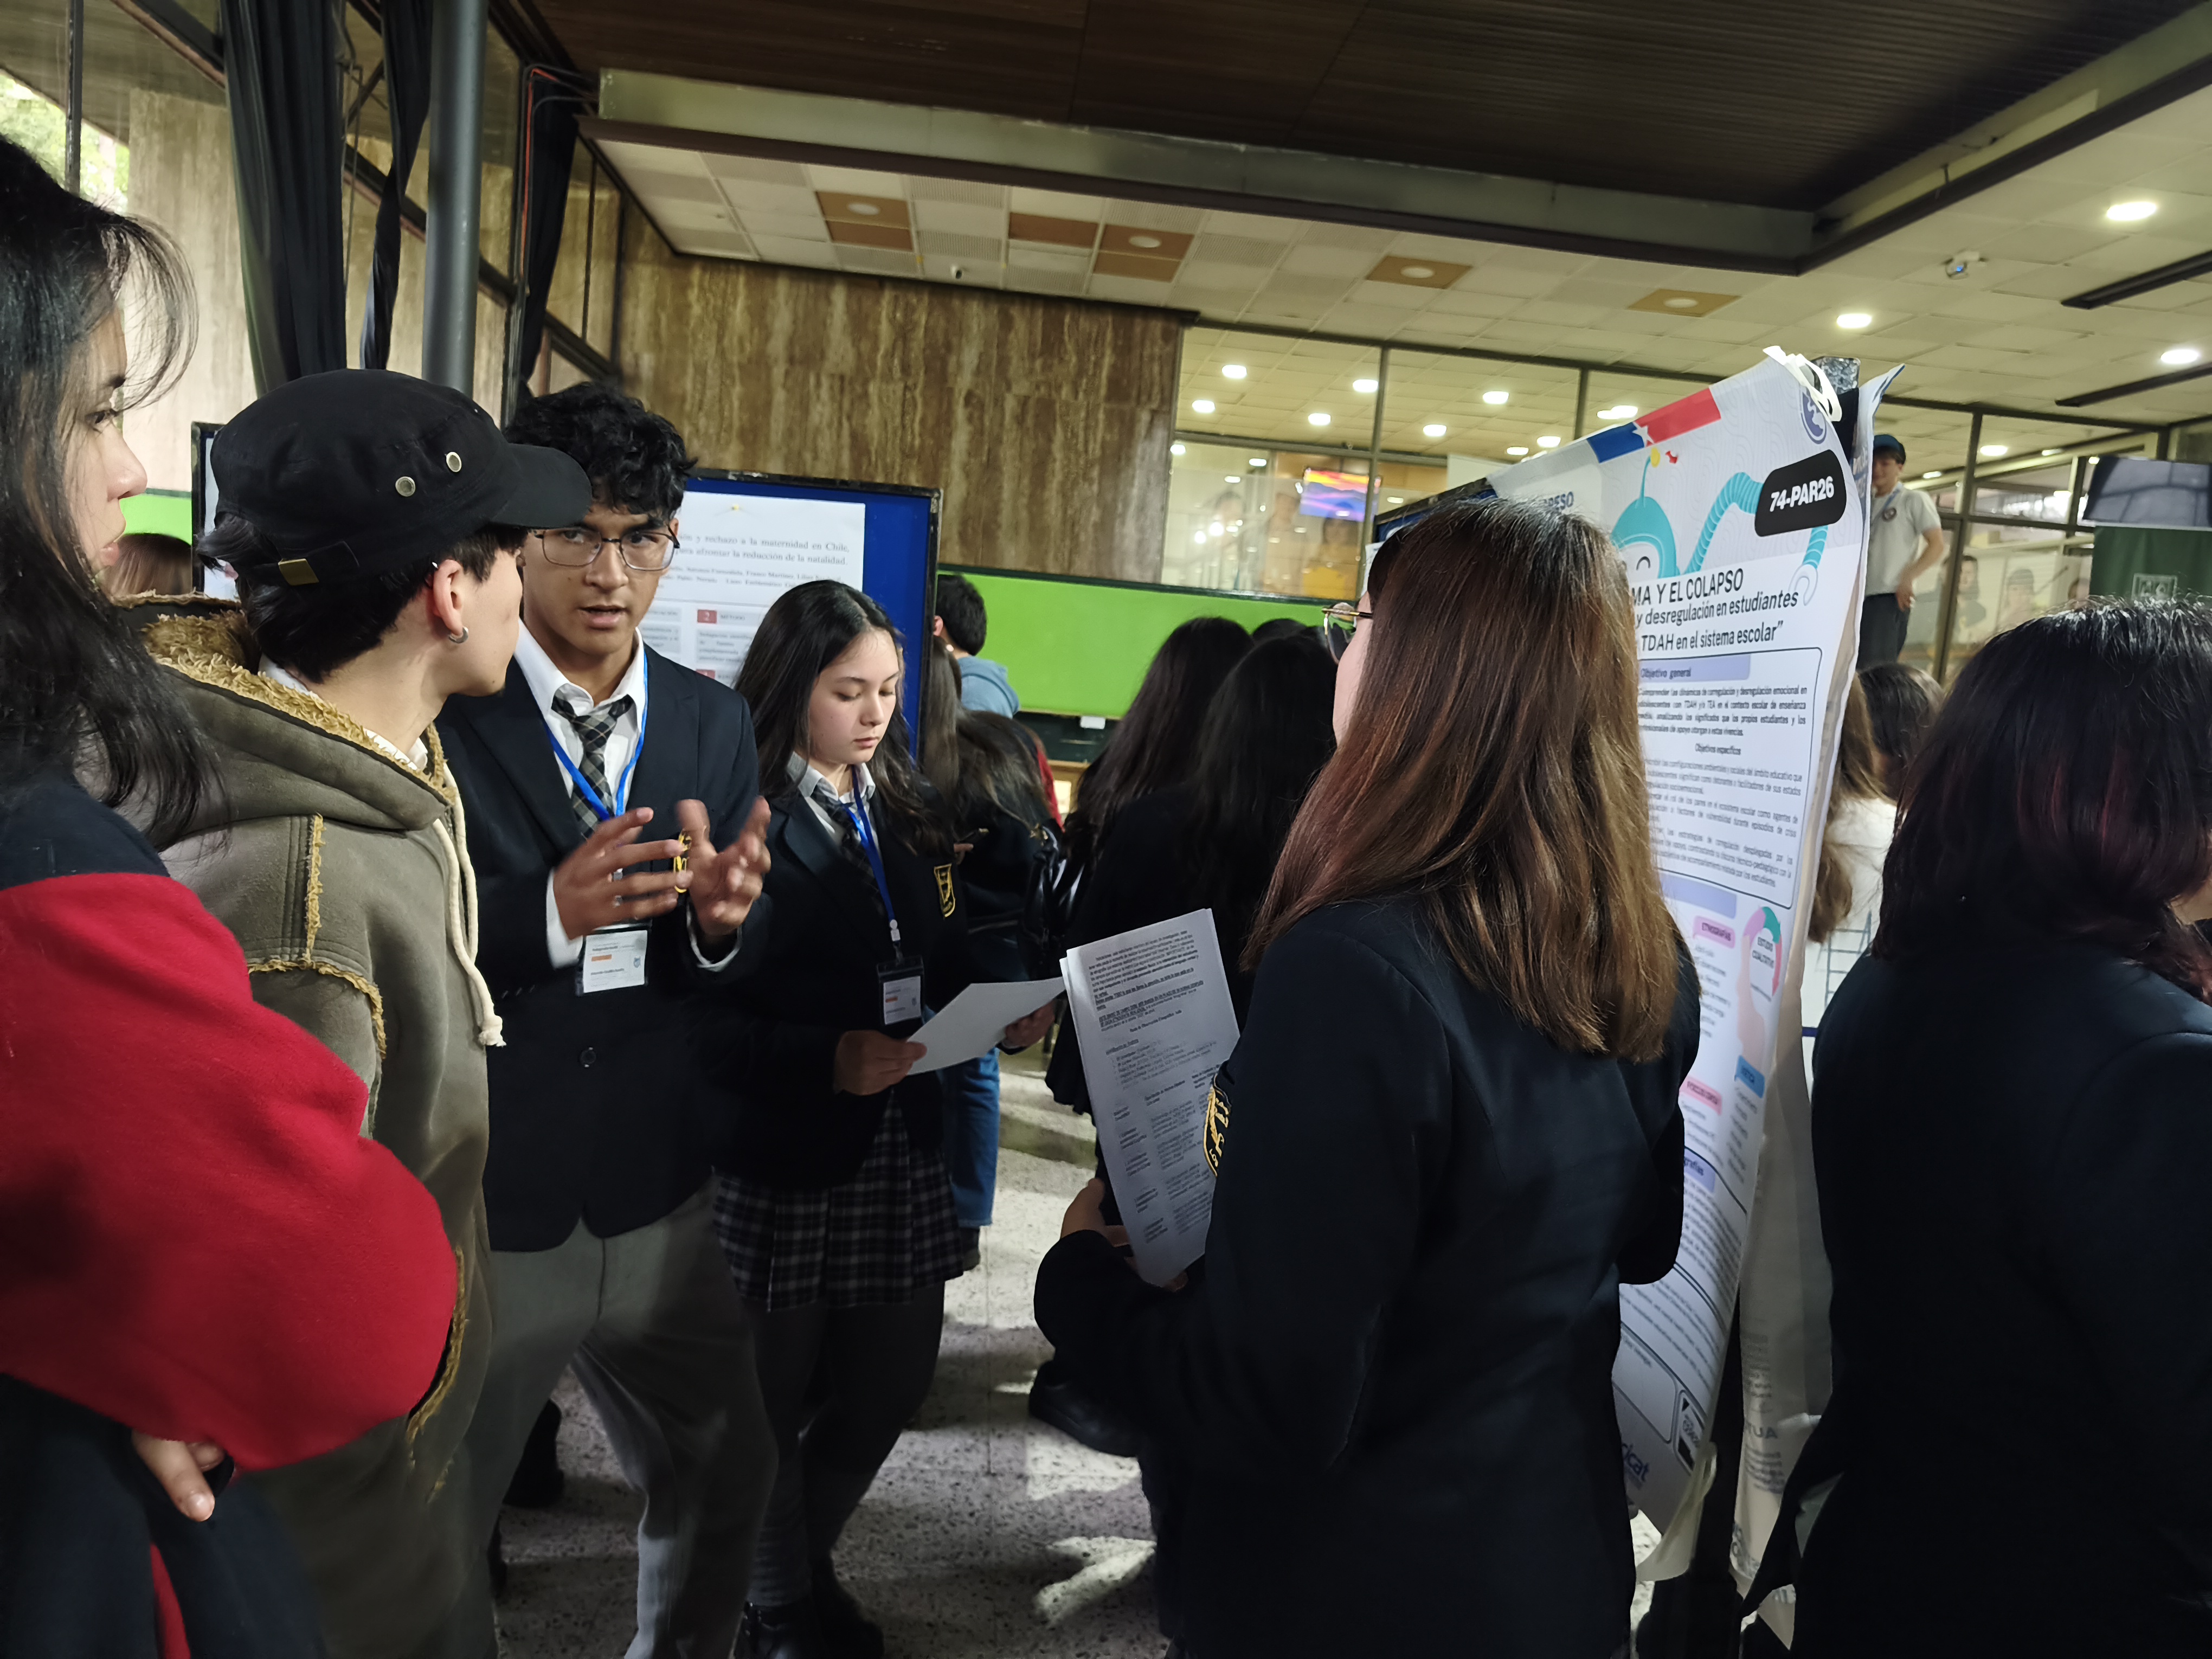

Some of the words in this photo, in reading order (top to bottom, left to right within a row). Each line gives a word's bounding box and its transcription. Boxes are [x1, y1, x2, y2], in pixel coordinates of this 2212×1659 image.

[1770, 476, 1835, 512] 74-PAR26
[696, 548, 730, 557] afrontar
[743, 551, 783, 560] reducción
[705, 536, 738, 544] rechazo
[762, 539, 808, 549] maternidad
[826, 543, 850, 553] Chile,
[1657, 583, 1667, 604] Y
[1669, 581, 1683, 603] EL
[1686, 568, 1744, 600] COLAPSO
[1636, 612, 1643, 629] y
[1645, 600, 1714, 626] desregulación
[1716, 604, 1727, 616] en
[1729, 590, 1798, 614] estudiantes
[1641, 634, 1674, 651] TDAH
[1676, 638, 1687, 650] en
[1690, 631, 1698, 648] el
[1700, 629, 1734, 647] sistema
